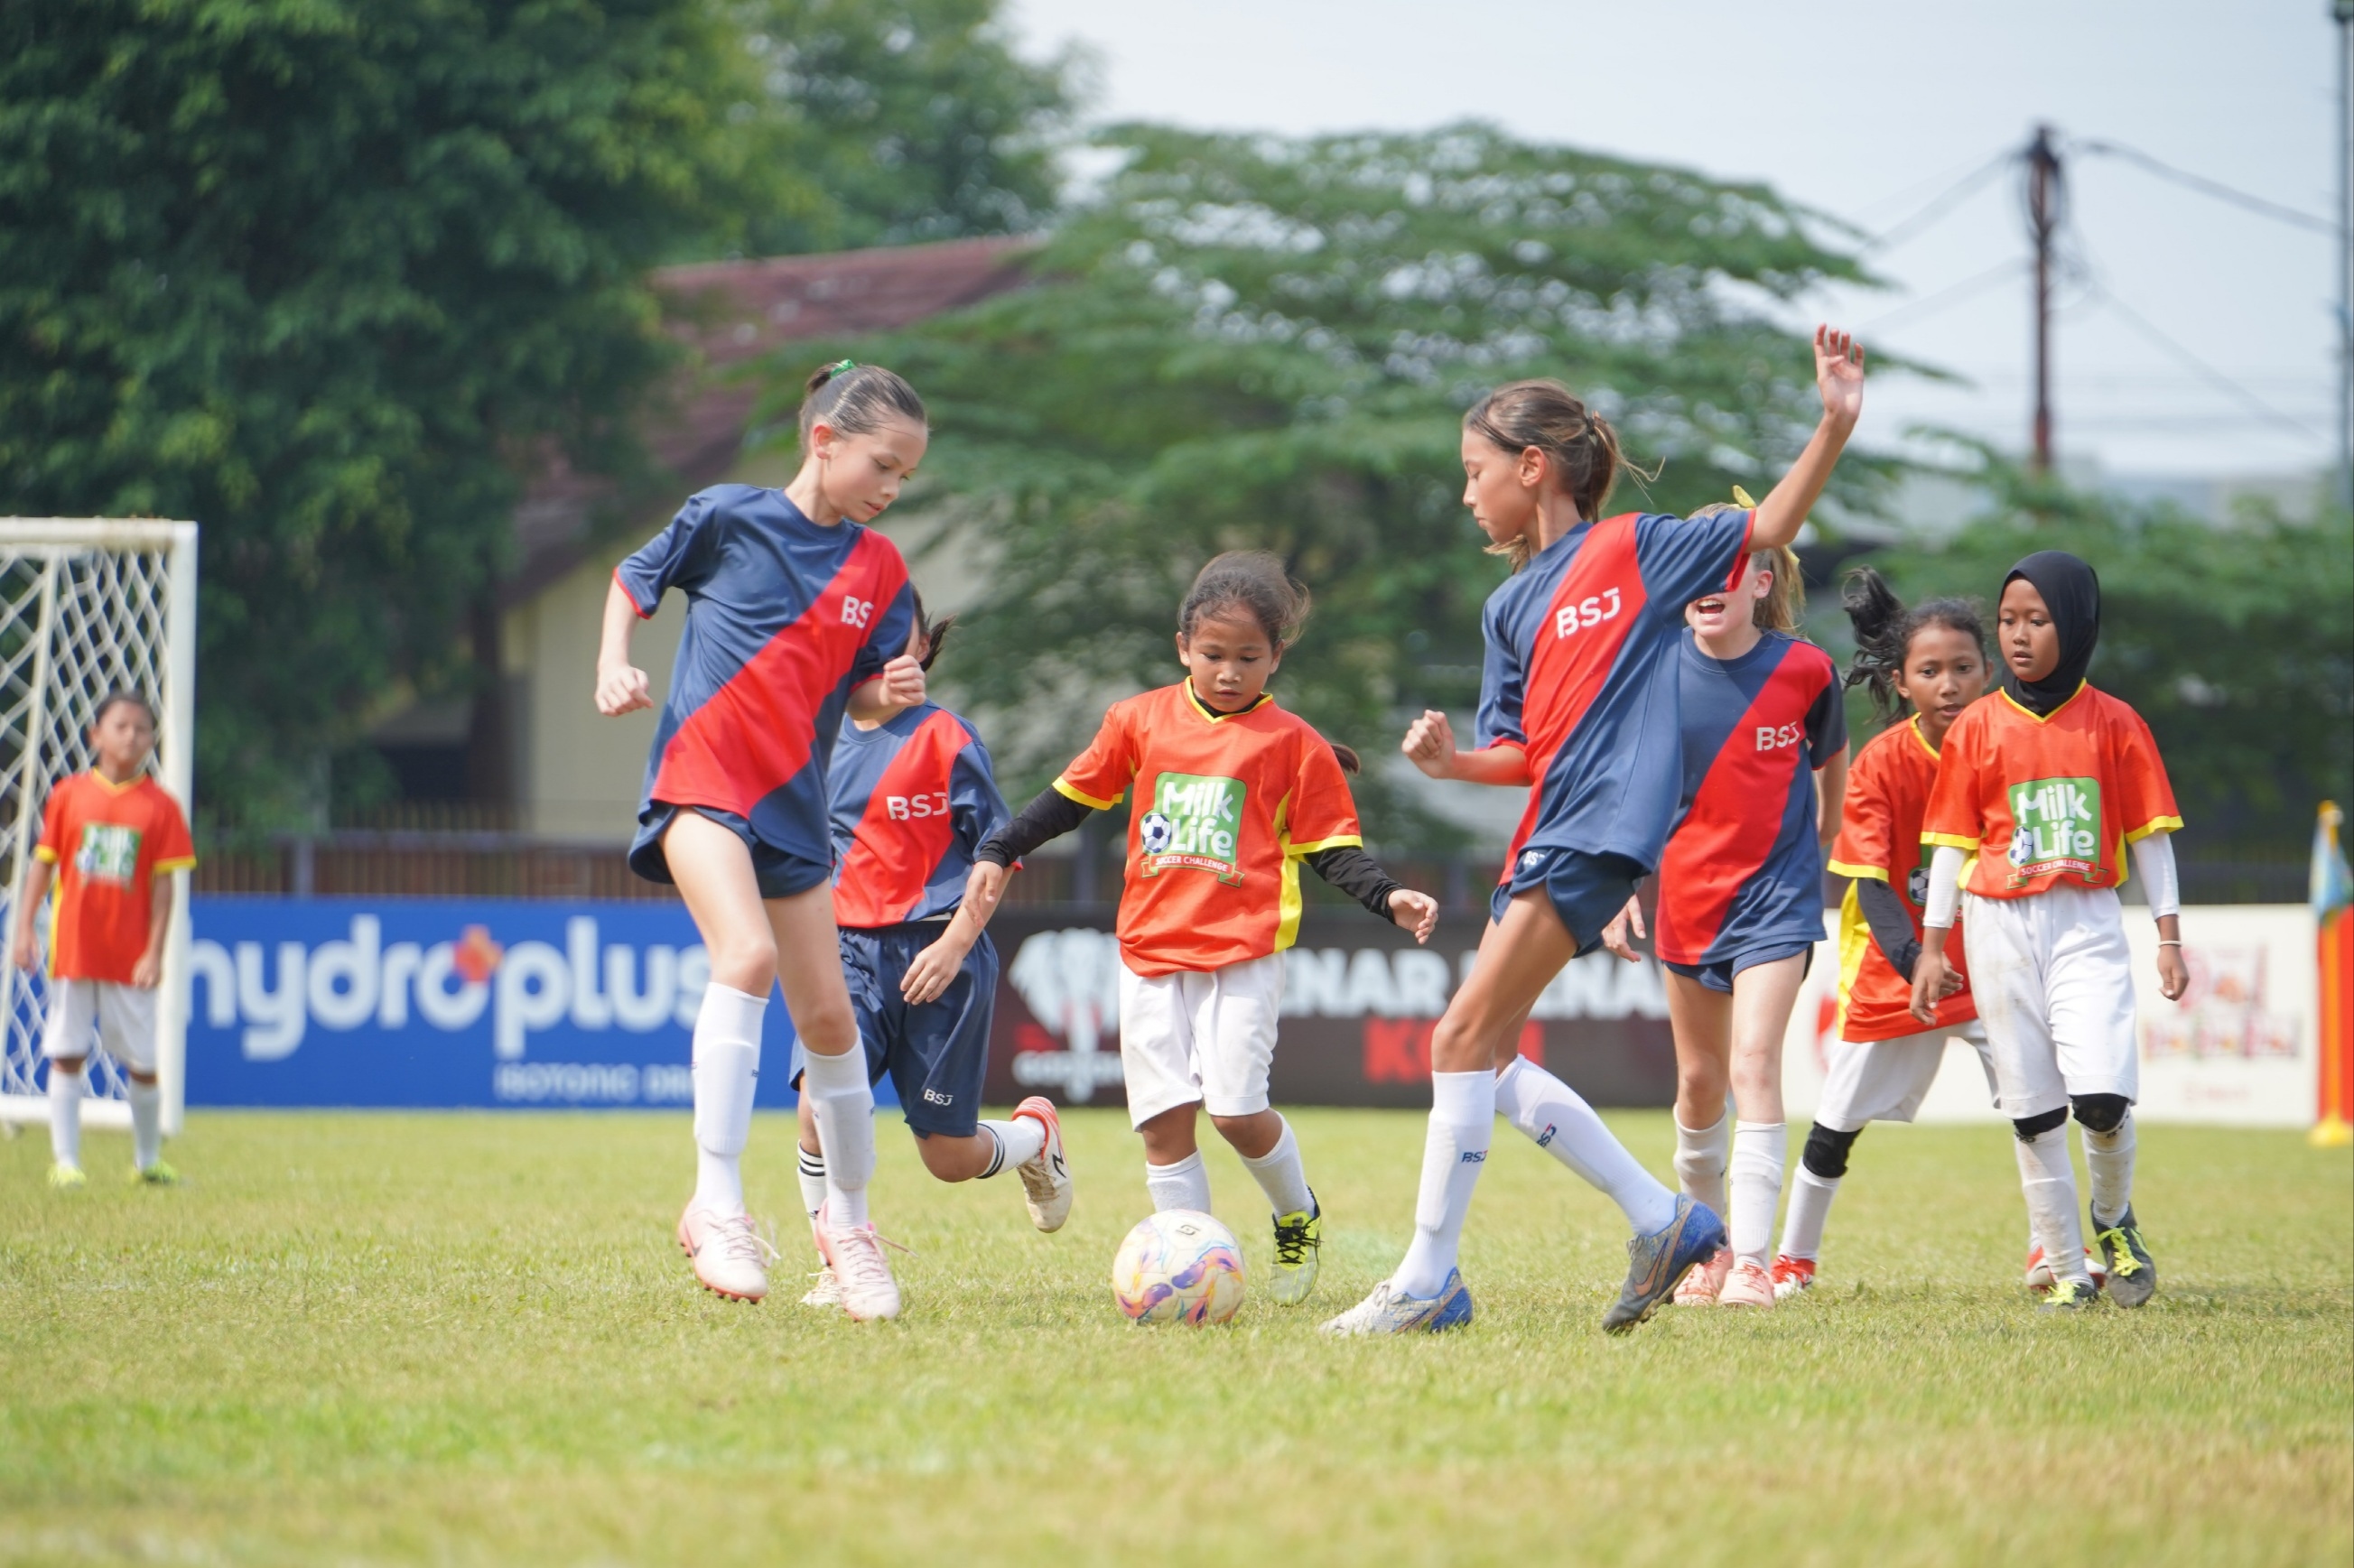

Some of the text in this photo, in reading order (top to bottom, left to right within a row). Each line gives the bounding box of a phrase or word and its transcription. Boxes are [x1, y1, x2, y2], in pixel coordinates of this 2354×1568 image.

[1557, 587, 1621, 639] BSJ
[1756, 720, 1800, 751] BSJ
[887, 792, 947, 821] BSJ
[1162, 782, 1233, 822] Milk
[2017, 784, 2092, 824] Milk
[1170, 817, 1233, 857] Life
[2033, 820, 2095, 858] Life
[1156, 855, 1228, 872] SOCCER CHALLENGE
[2022, 858, 2090, 876] SOCCER CHALLENGE
[187, 914, 712, 1060] hydroplus
[924, 1089, 954, 1106] BSJ
[1461, 1149, 1488, 1163] BSJ
